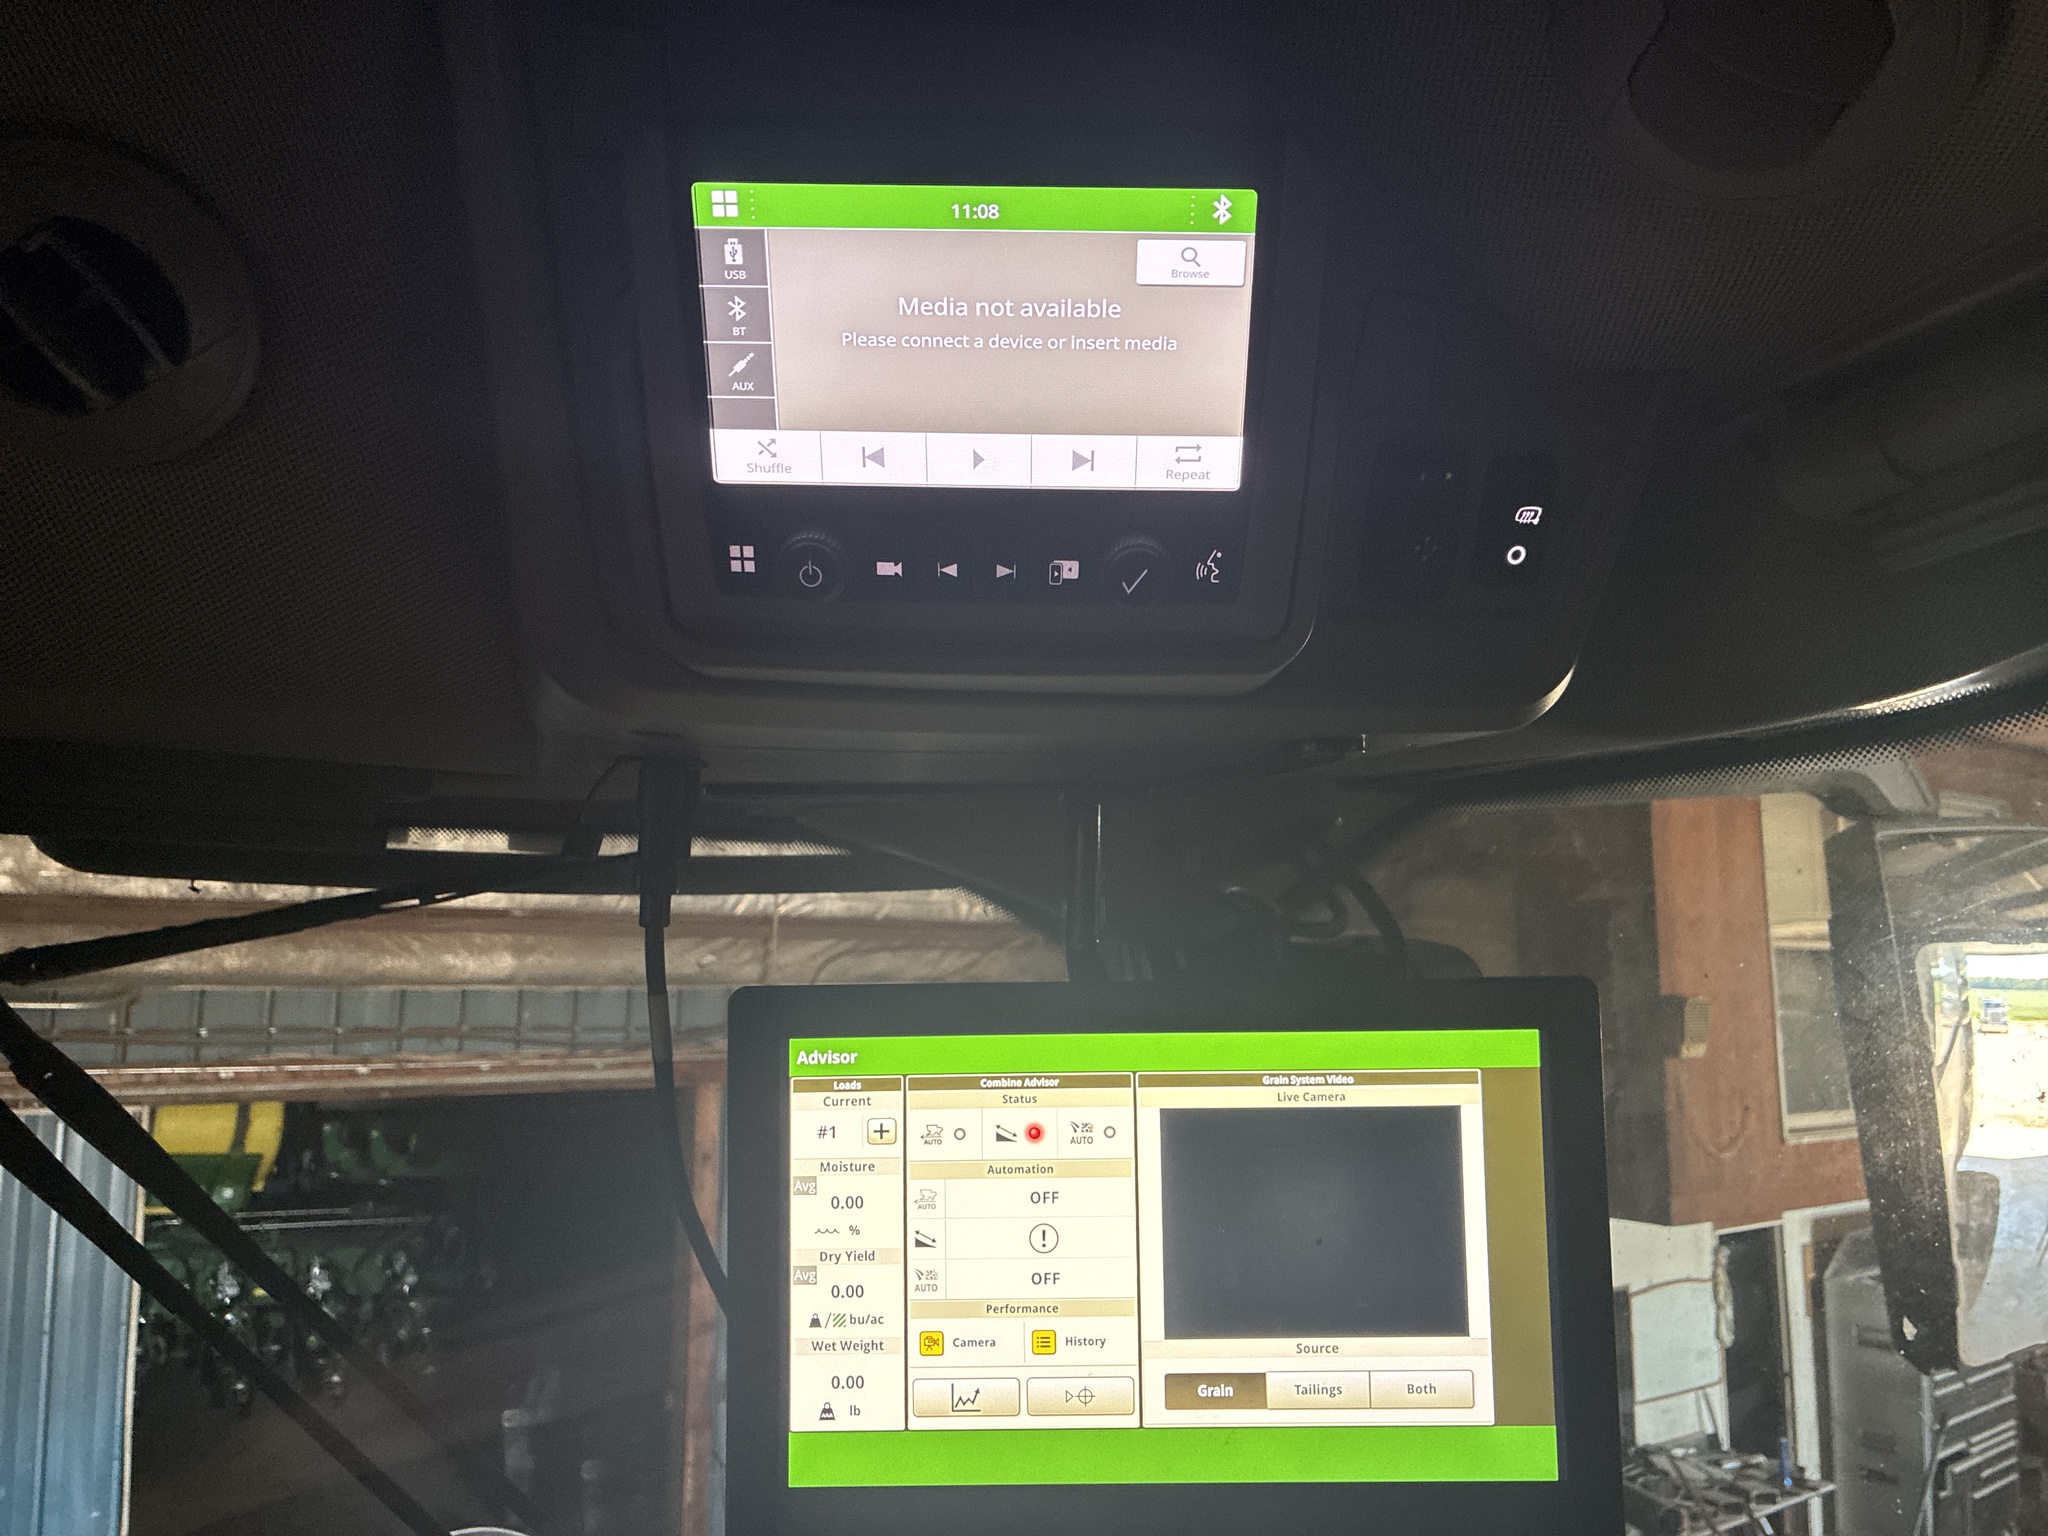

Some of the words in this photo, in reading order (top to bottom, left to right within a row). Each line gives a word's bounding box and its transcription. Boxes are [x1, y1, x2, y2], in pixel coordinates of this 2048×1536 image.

[951, 203, 1000, 220] 11:08
[724, 269, 747, 280] USB
[1171, 268, 1210, 280] Browse
[898, 297, 968, 318] Media
[975, 300, 1014, 318] not
[1019, 298, 1122, 319] available
[732, 326, 747, 336] BT
[841, 332, 896, 348] Please
[901, 334, 970, 349] connect
[974, 338, 984, 349] a
[988, 334, 1043, 350] device
[1047, 338, 1067, 350] or
[1070, 335, 1120, 351] insert
[1124, 335, 1177, 351] media
[732, 380, 755, 391] AUX
[746, 462, 793, 475] Shuffle
[1165, 469, 1211, 483] Repeat
[796, 1050, 858, 1065] Advisor
[833, 1080, 862, 1091] Loads
[980, 1078, 1022, 1088] Combine
[1024, 1077, 1060, 1088] Advisor
[1262, 1074, 1288, 1085] Grain
[1290, 1074, 1323, 1086] System
[1325, 1074, 1354, 1085] Video
[823, 1096, 872, 1107] Current
[1002, 1094, 1037, 1104] Status
[1277, 1093, 1300, 1102] Live
[1302, 1092, 1346, 1102] Camera
[817, 1126, 837, 1139] #1
[1070, 1136, 1094, 1145] AUTO
[820, 1161, 875, 1172] Moisture
[987, 1164, 1054, 1175] Automation
[794, 1180, 816, 1194] Avg
[831, 1195, 864, 1210] 0.00
[1030, 1191, 1059, 1204] OFF
[819, 1251, 841, 1265] Dry
[844, 1250, 875, 1262] Yield
[794, 1269, 816, 1283] Avg
[1031, 1272, 1061, 1285] OFF
[831, 1284, 864, 1299] 0.00
[914, 1283, 938, 1292] AUTO
[986, 1303, 1059, 1314] Performance
[850, 1313, 884, 1326] bu/ac
[811, 1340, 836, 1352] Wet
[839, 1339, 884, 1354] Weight
[952, 1337, 996, 1348] Camera
[1065, 1336, 1106, 1349] History
[1295, 1343, 1339, 1354] Source
[831, 1375, 864, 1389] 0.00
[1197, 1384, 1233, 1398] Grain
[1294, 1384, 1343, 1398] Tailings
[1406, 1383, 1437, 1395] Both
[850, 1404, 861, 1416] lb
